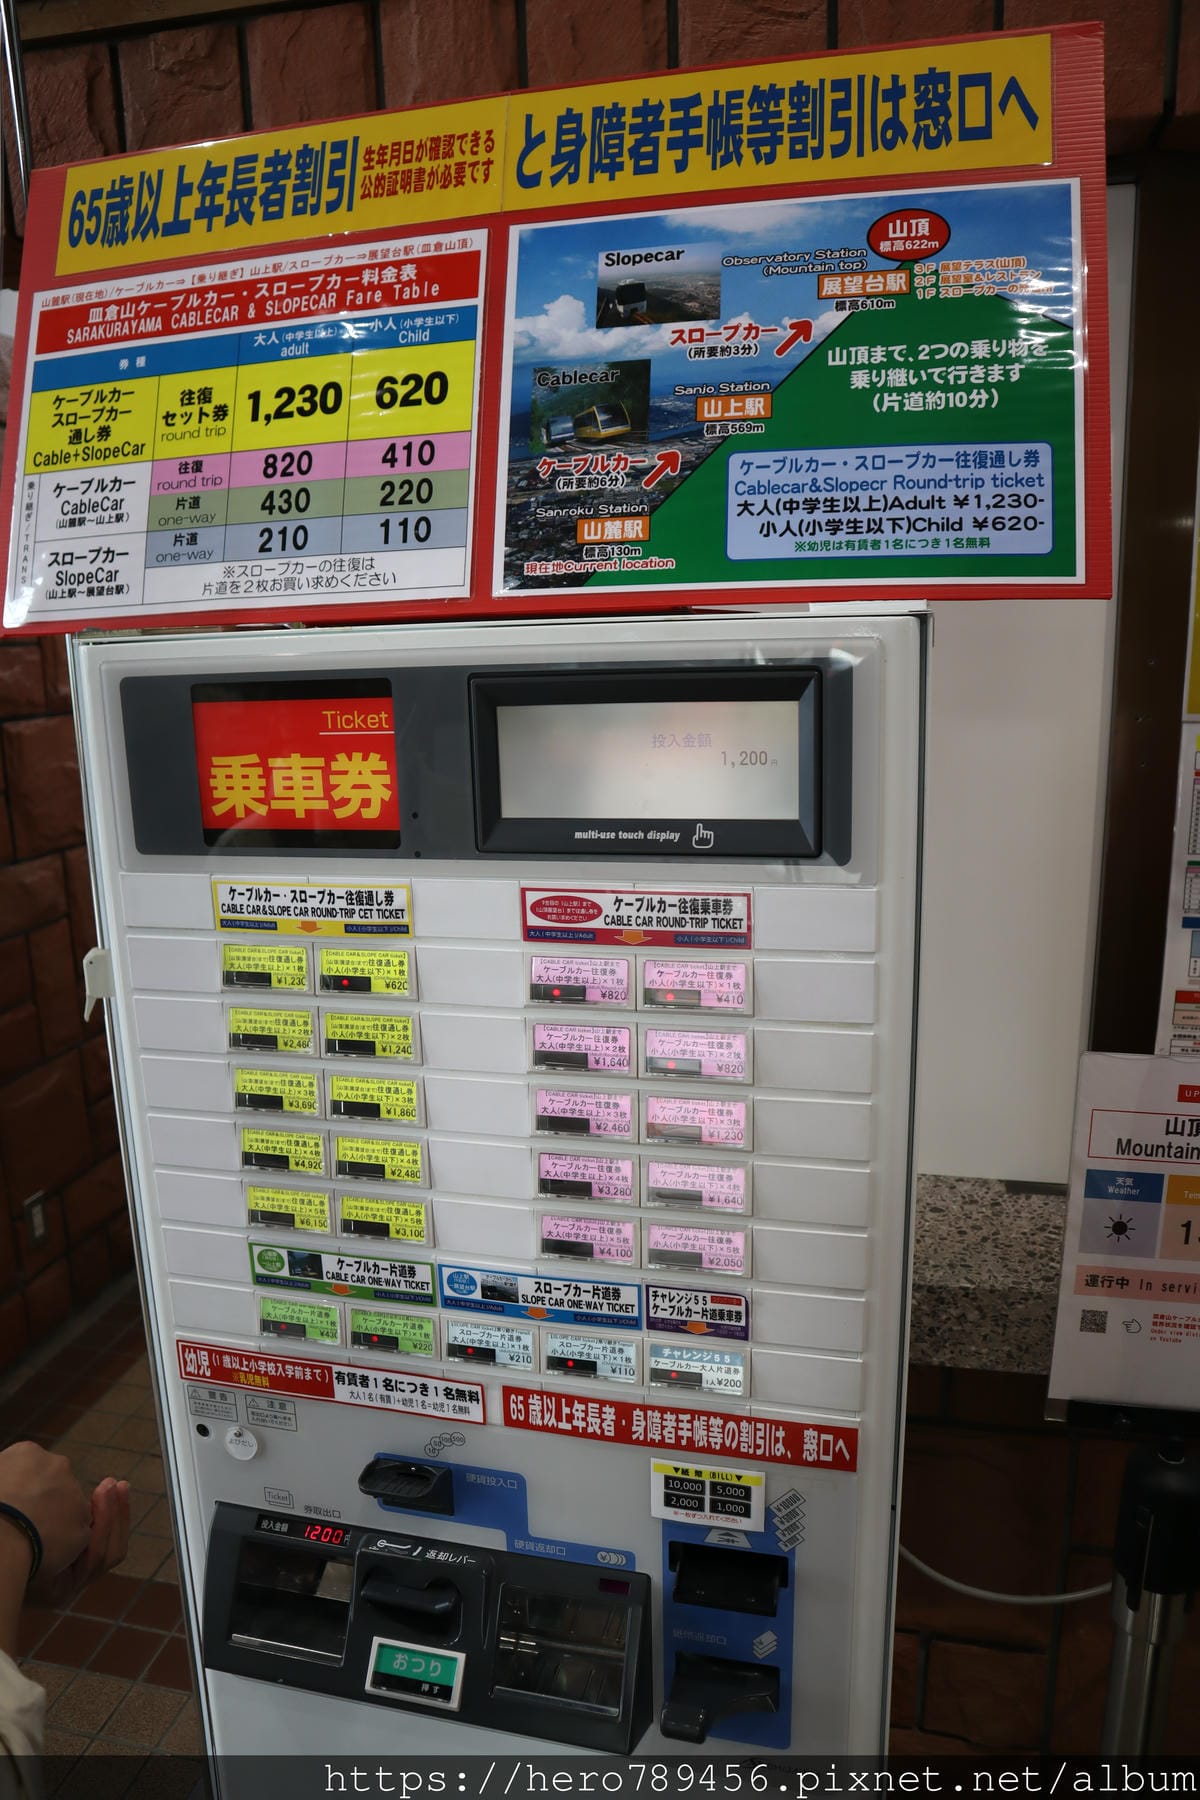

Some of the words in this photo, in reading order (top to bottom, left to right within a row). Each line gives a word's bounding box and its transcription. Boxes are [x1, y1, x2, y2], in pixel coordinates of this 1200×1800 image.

[515, 66, 1039, 189] と身障者手帳等割引は窓口へ
[67, 135, 361, 248] 65歳以上年長者割引
[361, 129, 495, 172] 生年月日が確認できる
[360, 157, 495, 201] 公的証明書が必要です
[887, 218, 930, 239] 山頂
[879, 239, 940, 252] 標高622m
[604, 247, 685, 268] Slopecar
[722, 252, 811, 267] Observatory
[815, 247, 867, 260] Station
[914, 263, 935, 275] 3F
[940, 256, 1027, 273] 展望テラス(山頂)
[762, 261, 835, 277] (Mountain
[838, 259, 867, 272] top)
[822, 272, 907, 296] 展望台駅
[914, 276, 935, 287] 2F
[88, 264, 417, 324] 皿倉山ケーブルカー・スロープカー料金表
[916, 288, 935, 299] 1F
[66, 316, 162, 345] SARAKURAYAMA
[171, 306, 239, 330] CABLECAR
[247, 303, 256, 319] &
[265, 293, 337, 316] SLOPECAR
[346, 289, 382, 306] Fare
[393, 281, 440, 300] Table
[834, 299, 896, 313] 標高610m
[399, 329, 430, 344] Child
[670, 322, 779, 346] スロープカー
[281, 342, 309, 357] adult
[688, 345, 759, 361] (所要約3分)
[827, 337, 1050, 367] 山頂まで、2つの乗り物を
[536, 369, 620, 388] Cablecar
[849, 362, 1026, 390] 乗り継いで行きます
[53, 387, 135, 410] ケーブルカー
[179, 387, 213, 407] 往復
[375, 371, 449, 411] 620
[674, 385, 715, 397] Sanjo
[719, 381, 771, 394] Station
[247, 381, 344, 426] 1,230
[703, 397, 765, 418] 山上駅
[871, 388, 1001, 413] (片道約10分)
[51, 405, 132, 428] スロープカー
[162, 404, 229, 426] セット券
[67, 425, 111, 446] 通し券
[161, 428, 200, 442] round
[205, 425, 227, 439] trip
[705, 423, 764, 437] 標高569m
[33, 441, 146, 467] Cable+SlopeCar
[381, 439, 436, 468] 410
[740, 449, 1040, 475] ケーブルカー・スロープカー往復通し券
[178, 460, 203, 475] 往復
[262, 450, 314, 479] 820
[537, 453, 647, 478] ケーブルカー
[53, 476, 136, 498] ケーブルカー
[157, 477, 197, 491] round
[201, 474, 223, 489] trip
[379, 478, 434, 506] 220
[556, 474, 626, 491] (所要約6分)
[735, 477, 887, 496] Cablecar&Slopecr
[894, 473, 985, 491] Round-trip
[991, 472, 1045, 488] ticket
[61, 496, 125, 516] CableCar
[175, 496, 201, 510] 片道
[260, 487, 312, 515] 430
[536, 505, 594, 518] Sanroku
[598, 503, 648, 514] Station
[736, 494, 946, 517] 大人(中学生以上)Adult
[953, 493, 1045, 511] ¥1,230-
[158, 511, 216, 527] one-way
[759, 515, 963, 538] 小人(小学生以下)Child
[972, 515, 1045, 531] ¥620-
[173, 532, 199, 547] 片道
[258, 524, 309, 553] 210
[379, 516, 432, 544] 110
[583, 519, 643, 541] 山麓駅
[47, 547, 129, 567] スロープカー
[156, 549, 214, 564] one-way
[583, 545, 642, 559] 標高130m
[525, 559, 618, 575] 現在地Current
[622, 558, 675, 571] location
[55, 568, 120, 587] SlopeCar
[322, 710, 389, 730] Ticket
[651, 732, 713, 749] 投入金額
[209, 751, 391, 819] 乗車券
[574, 828, 616, 841] multi-use
[618, 829, 644, 842] touch
[646, 829, 681, 844] display
[228, 886, 394, 906] ケーブルカー・スロープカー往復通し券
[613, 895, 733, 915] ケーブルカー往復乗車券
[221, 903, 244, 915] CABLE
[246, 904, 291, 917] CAR&SLOPE
[294, 906, 309, 917] CAR
[311, 906, 356, 919] ROUND-TRIP
[358, 908, 374, 919] CET
[376, 908, 405, 920] TICKET
[604, 914, 633, 927] CABLE
[635, 915, 653, 927] CAR
[656, 916, 708, 929] ROUND-TRIP
[711, 918, 744, 930] TICKET
[600, 990, 627, 1001] ¥820
[1116, 1138, 1200, 1161] Mountain
[1107, 1185, 1140, 1197] Weather
[1115, 1176, 1134, 1186] 天気
[336, 1257, 416, 1278] ケーブルカー片道券
[325, 1271, 349, 1282] CABLE
[351, 1274, 366, 1285] CAR
[370, 1276, 402, 1288] ONE-WAY
[404, 1279, 430, 1291] TICKET
[534, 1281, 621, 1301] スロープカー片道券
[1084, 1273, 1130, 1290] 運行中
[1139, 1278, 1153, 1292] In
[521, 1294, 547, 1306] SLOPE
[548, 1297, 566, 1308] CAR
[567, 1299, 605, 1311] ONE-WAY
[607, 1302, 636, 1314] TICKET
[651, 1291, 708, 1305] チャレンジ55
[651, 1304, 743, 1323] ケーブルカー片道乗車券
[184, 1350, 211, 1377] 幼児
[509, 1354, 532, 1364] ¥210
[610, 1367, 635, 1377] ¥110
[334, 1370, 480, 1405] 有賃者1名につき1名無料
[509, 1392, 851, 1463] 65歳以上年長者・身障者手帳等の割引は、窓口へ
[668, 1480, 703, 1493] 10,000
[716, 1485, 745, 1498] 5,000
[303, 1505, 341, 1519] 券取出口
[670, 1497, 699, 1510] 2,000
[716, 1502, 745, 1514] 1,000
[304, 1525, 344, 1545] 1200
[425, 1549, 477, 1564] 返却レバー
[392, 1653, 442, 1677] おつり
[421, 1682, 441, 1695] 押す
